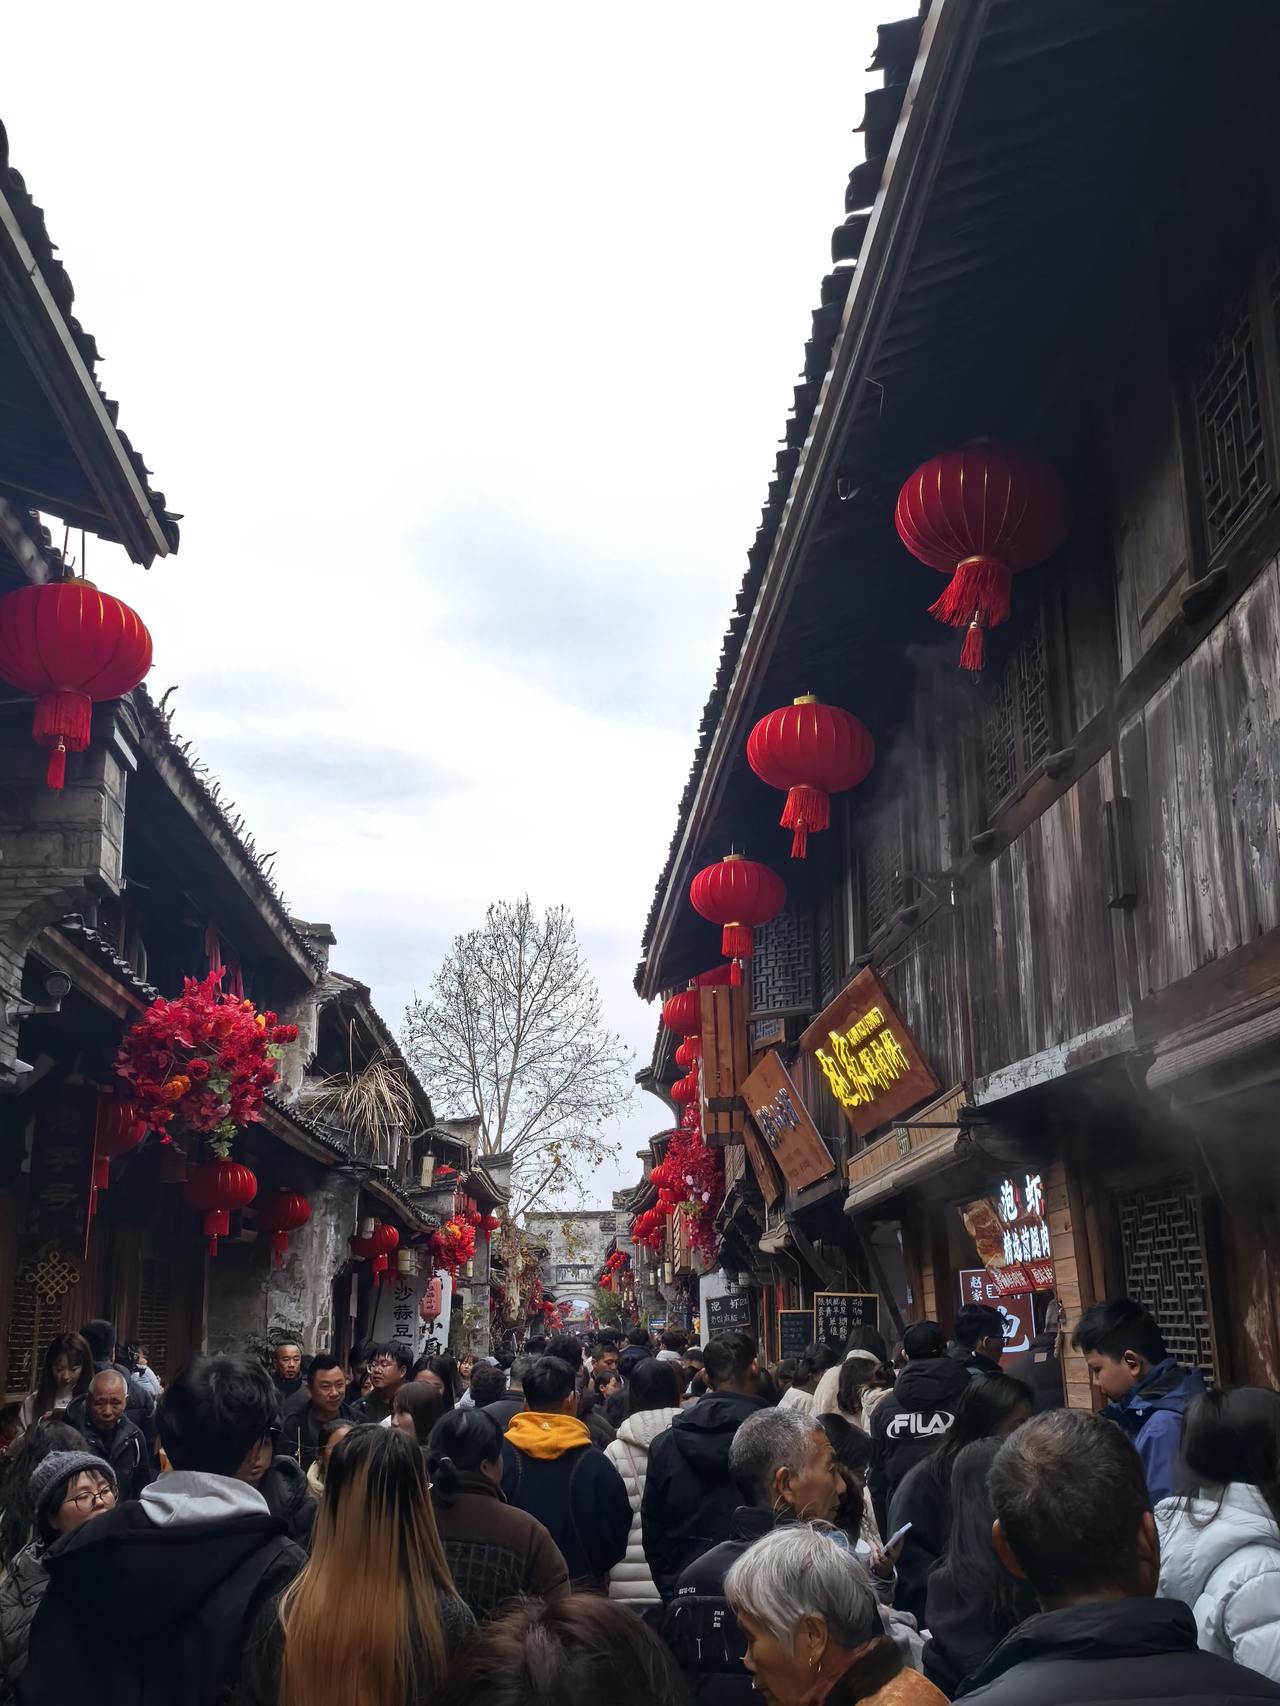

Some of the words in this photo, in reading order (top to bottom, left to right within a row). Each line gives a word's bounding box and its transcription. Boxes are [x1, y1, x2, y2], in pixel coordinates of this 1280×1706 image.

[998, 1174, 1042, 1222] 泡虾
[1003, 1220, 1051, 1266] 精选前腿肉
[970, 1276, 983, 1302] 赵家
[393, 1282, 414, 1347] 沙蒜豆
[894, 1413, 946, 1434] FILA
